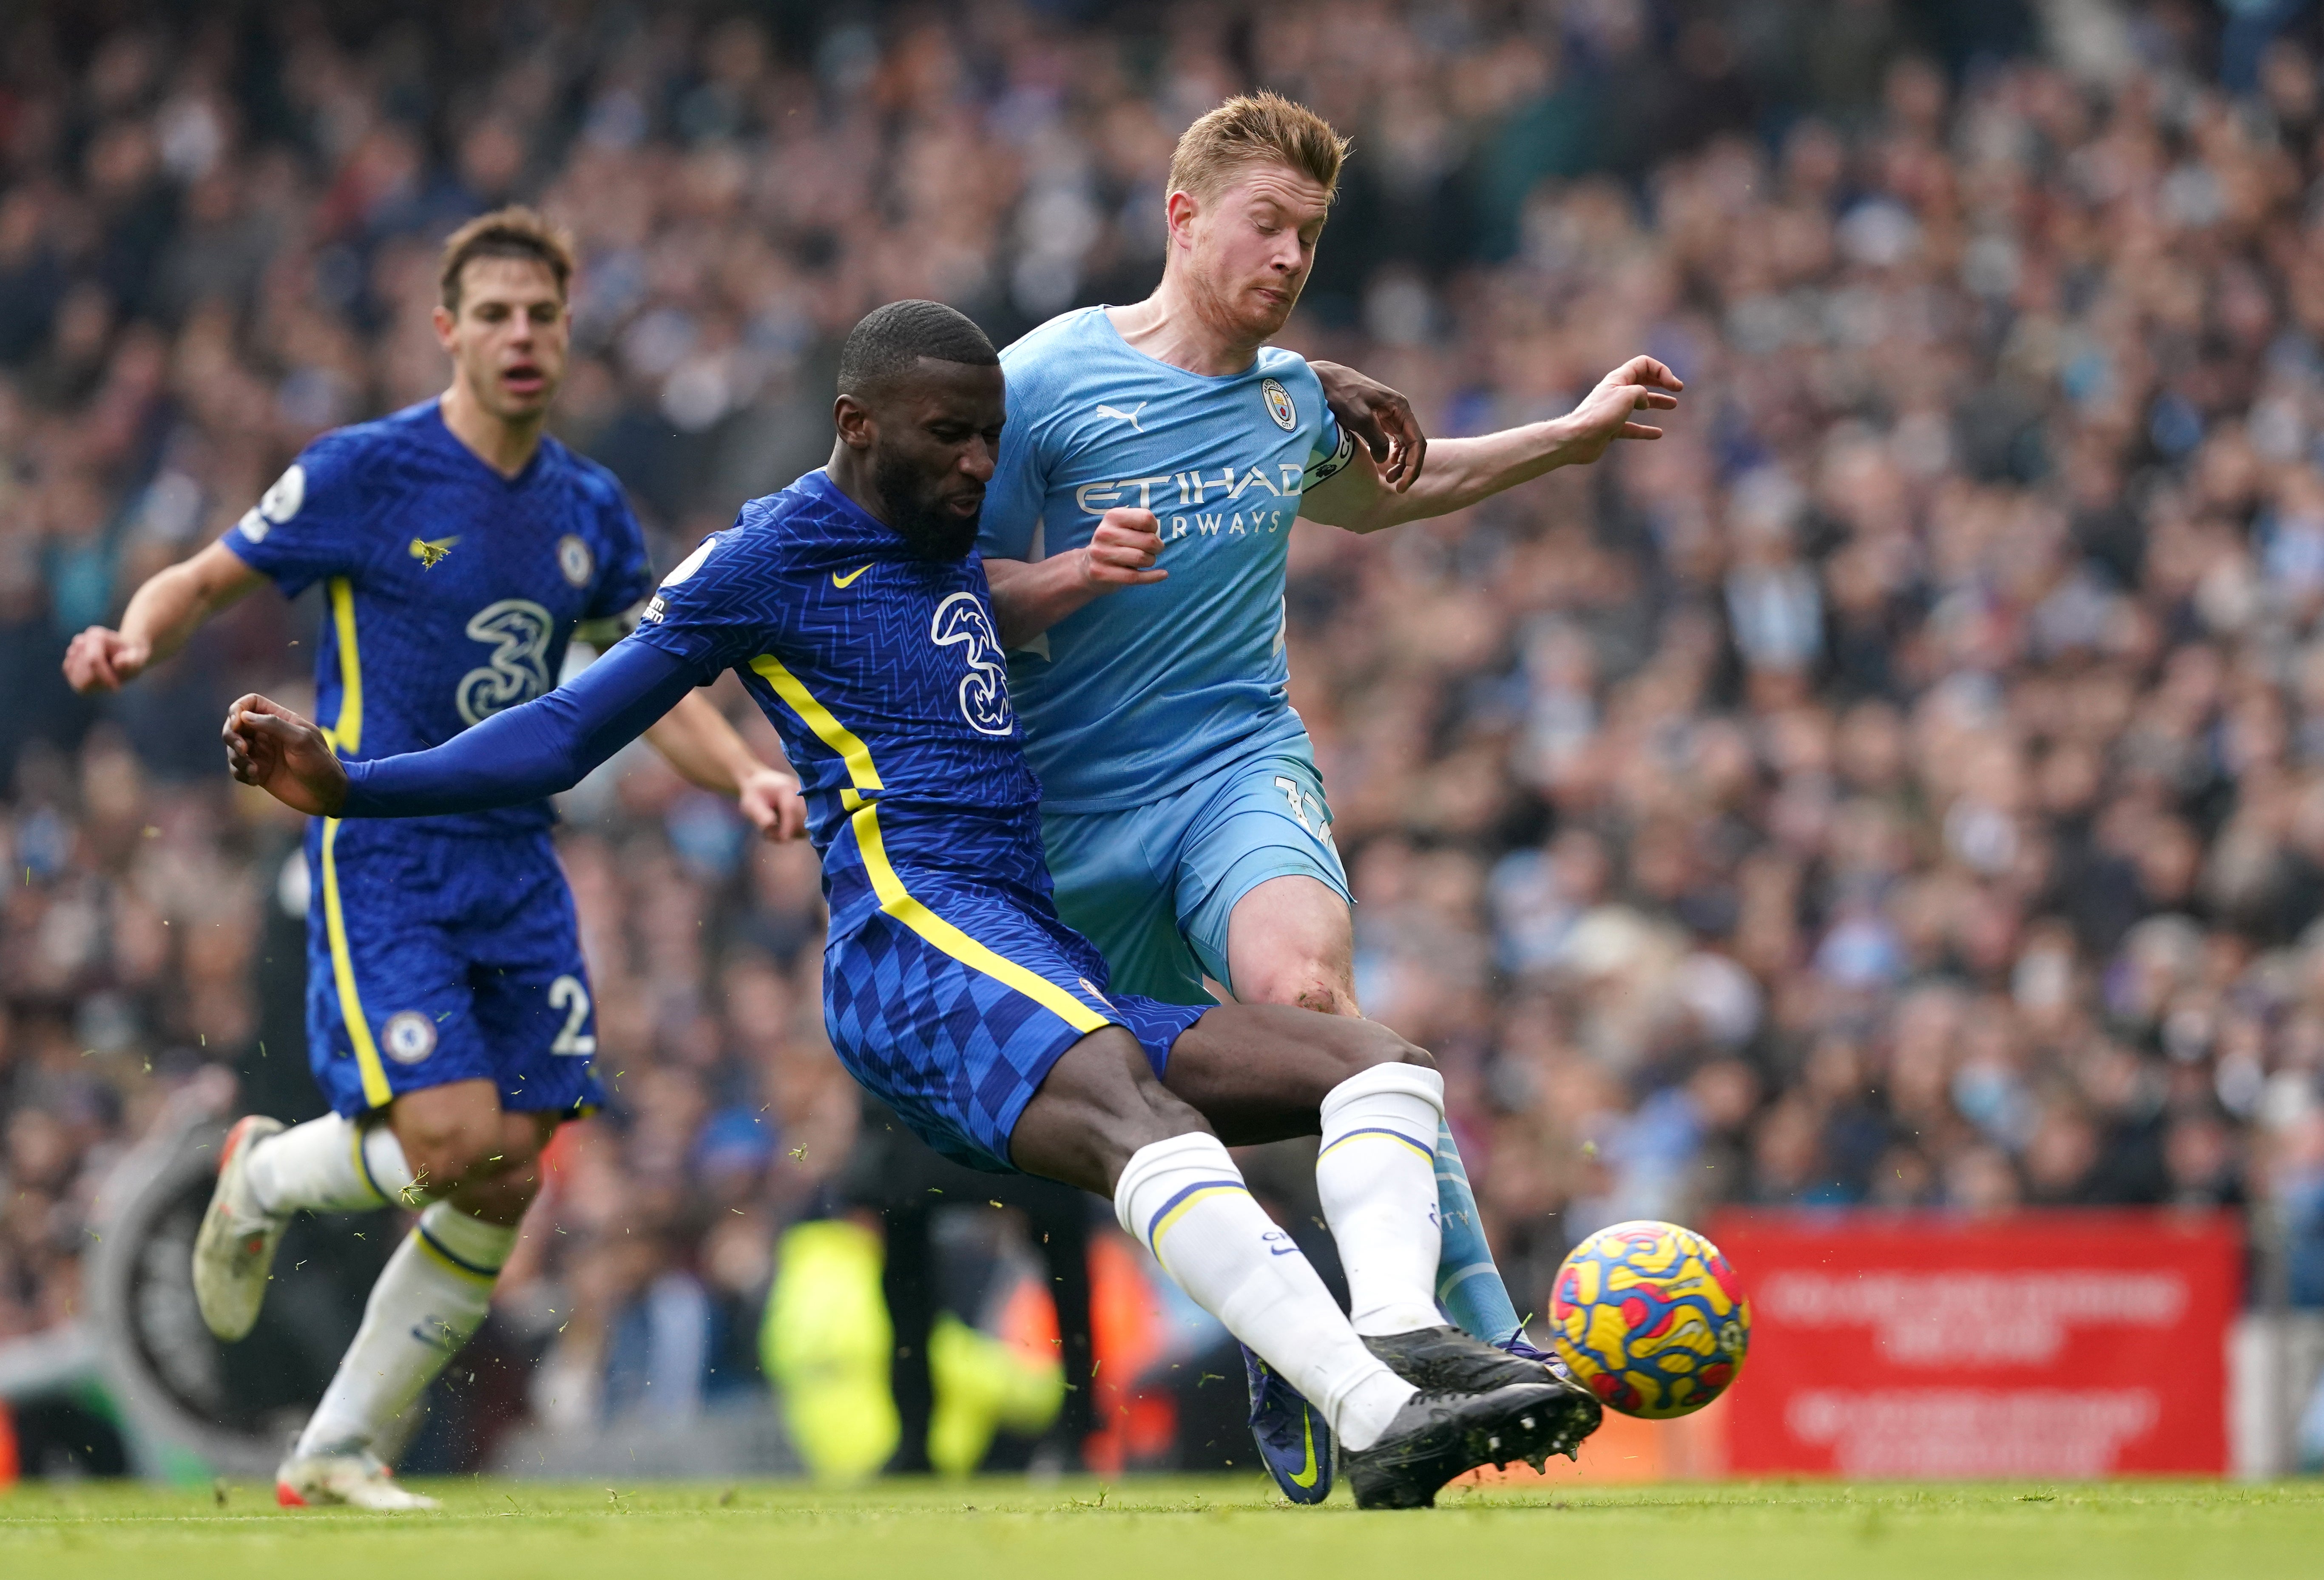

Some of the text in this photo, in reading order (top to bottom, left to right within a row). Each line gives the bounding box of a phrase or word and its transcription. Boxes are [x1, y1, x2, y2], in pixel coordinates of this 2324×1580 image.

[1264, 380, 1289, 399] MANCHESTER
[1076, 463, 1303, 515] ETIHAD
[1155, 511, 1281, 539] IRWAYS
